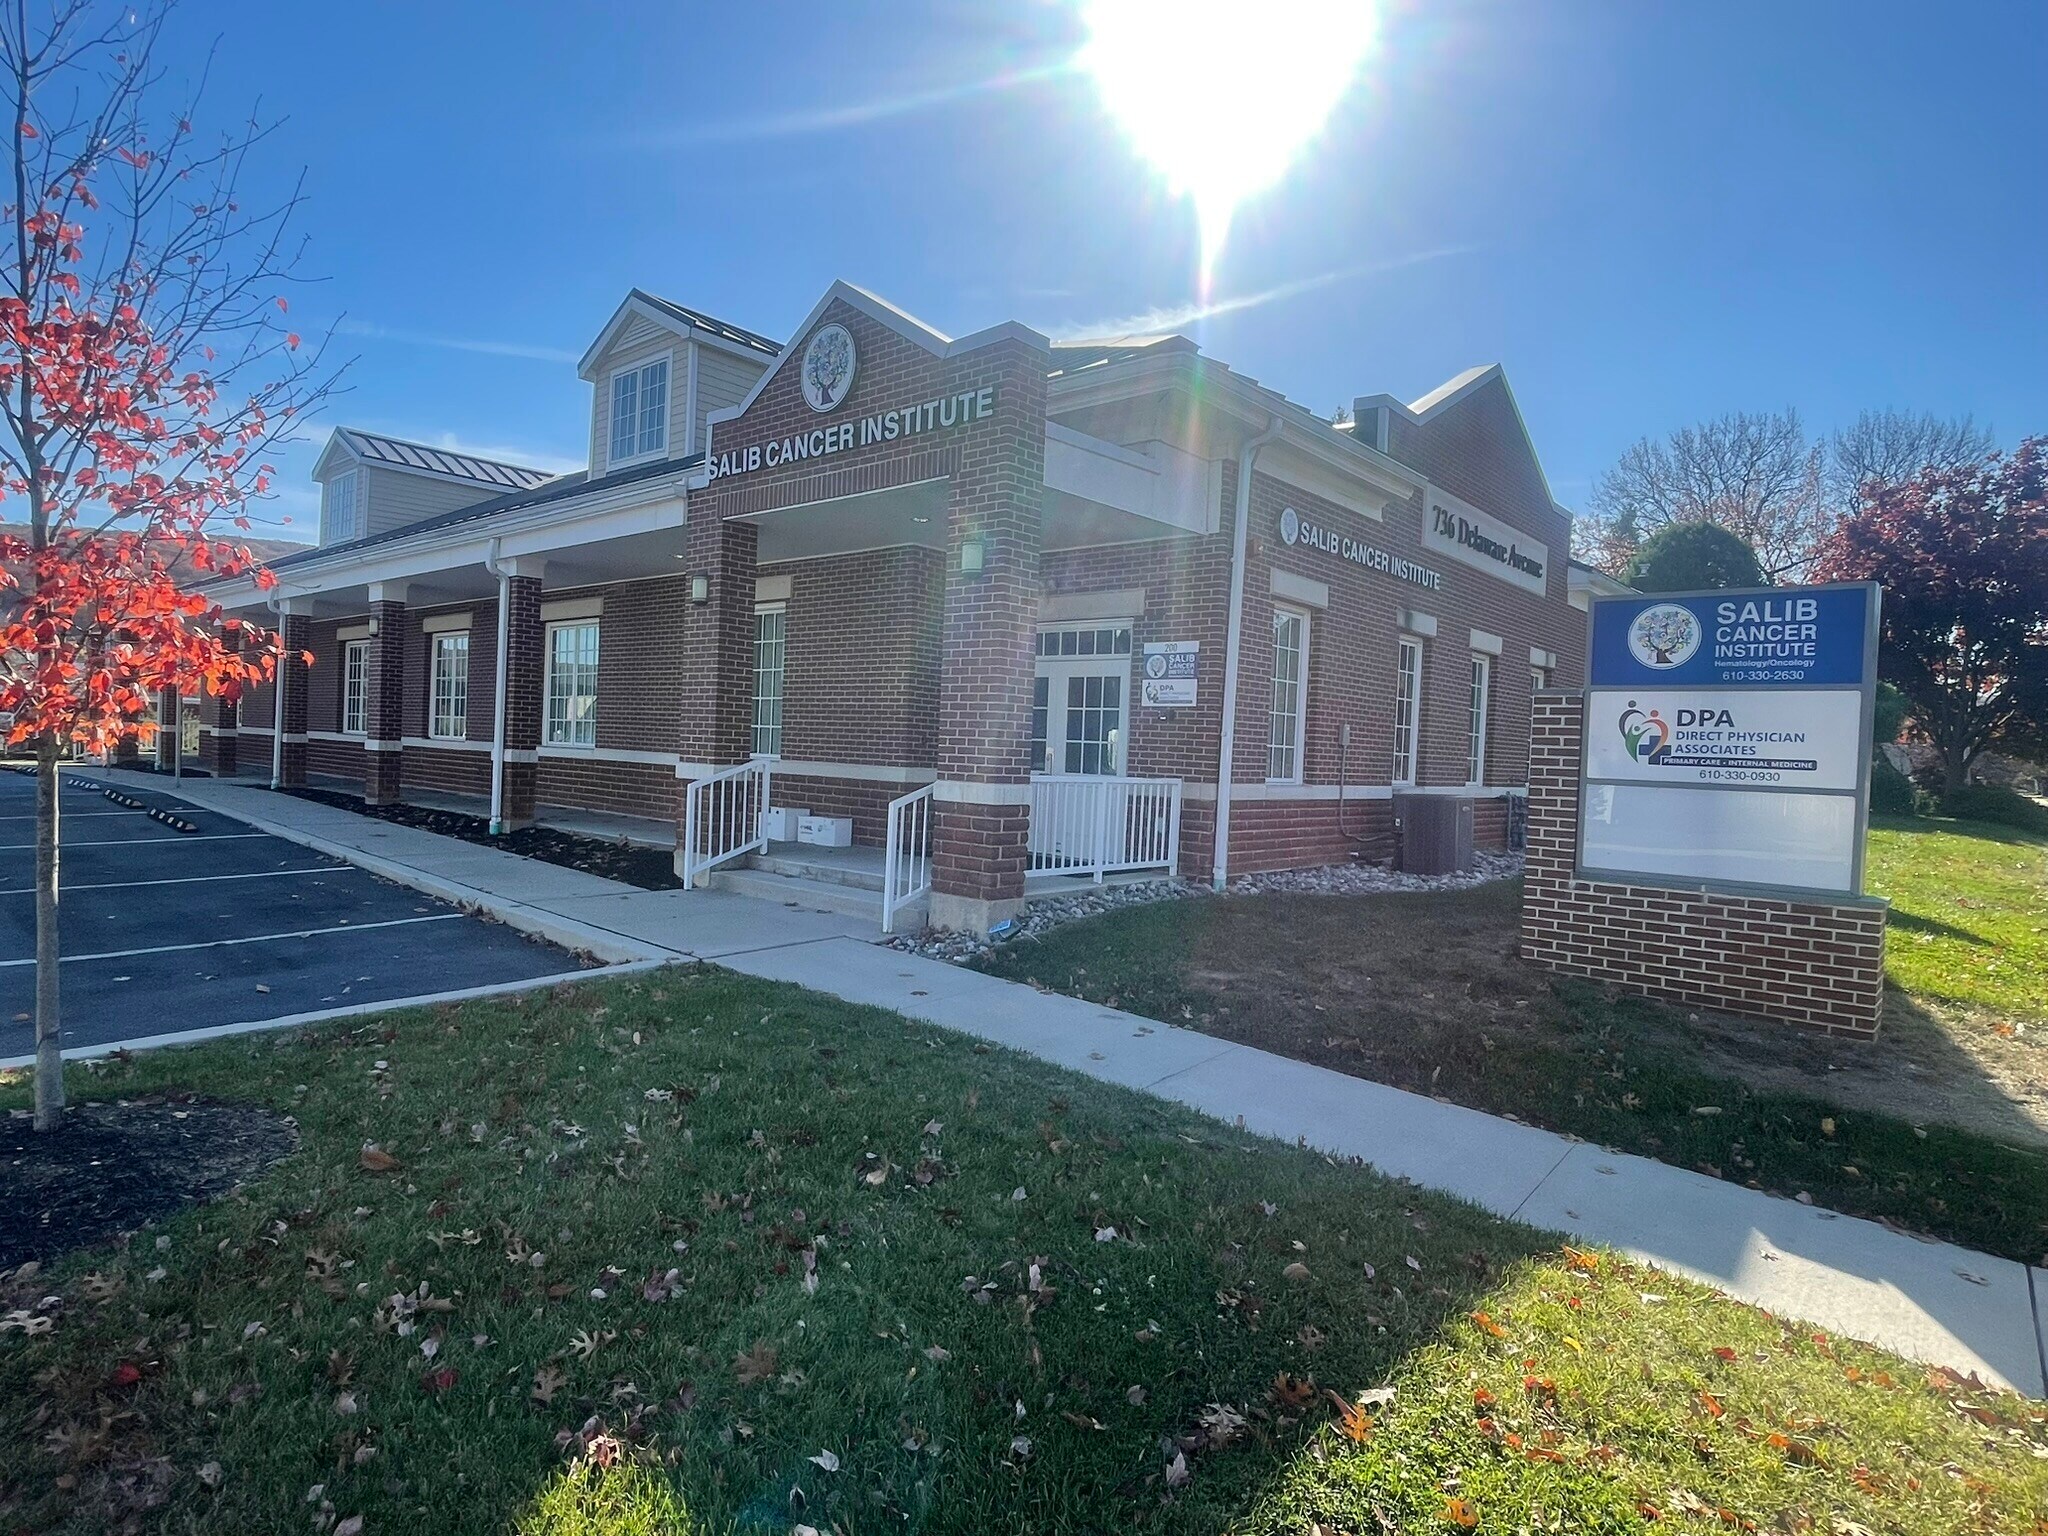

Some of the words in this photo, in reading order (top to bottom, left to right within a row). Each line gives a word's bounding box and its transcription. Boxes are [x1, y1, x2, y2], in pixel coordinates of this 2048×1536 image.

[708, 446, 761, 480] SALIB
[765, 424, 854, 468] CANCER
[860, 387, 994, 445] INSTITUTE
[1432, 504, 1456, 539] 736
[1457, 517, 1508, 563] Delaware
[1507, 544, 1543, 578] Avenue
[1300, 521, 1339, 554] SALIB
[1342, 537, 1388, 573] CANCER
[1391, 556, 1441, 590] INSTITUTE
[1717, 599, 1818, 625] SALIB
[1716, 624, 1817, 643] CANCER
[1164, 643, 1177, 652] 200
[1714, 642, 1816, 658] INSTITUTE
[1169, 654, 1195, 663] SALIB
[1714, 659, 1815, 669] Hematology/Oncology
[1722, 670, 1804, 681] 610-330-2630
[1676, 709, 1735, 728] DPA
[1675, 731, 1723, 741] DIRECT
[1727, 732, 1805, 743] PHYSICIAN
[1675, 744, 1756, 756] ASSOCIATES
[1663, 757, 1700, 765] PRIMARY
[1700, 758, 1721, 766] CARE
[1728, 760, 1770, 768] INTERNAL
[1771, 761, 1813, 769] MEDICINE
[1699, 770, 1781, 782] 610-330-0930
